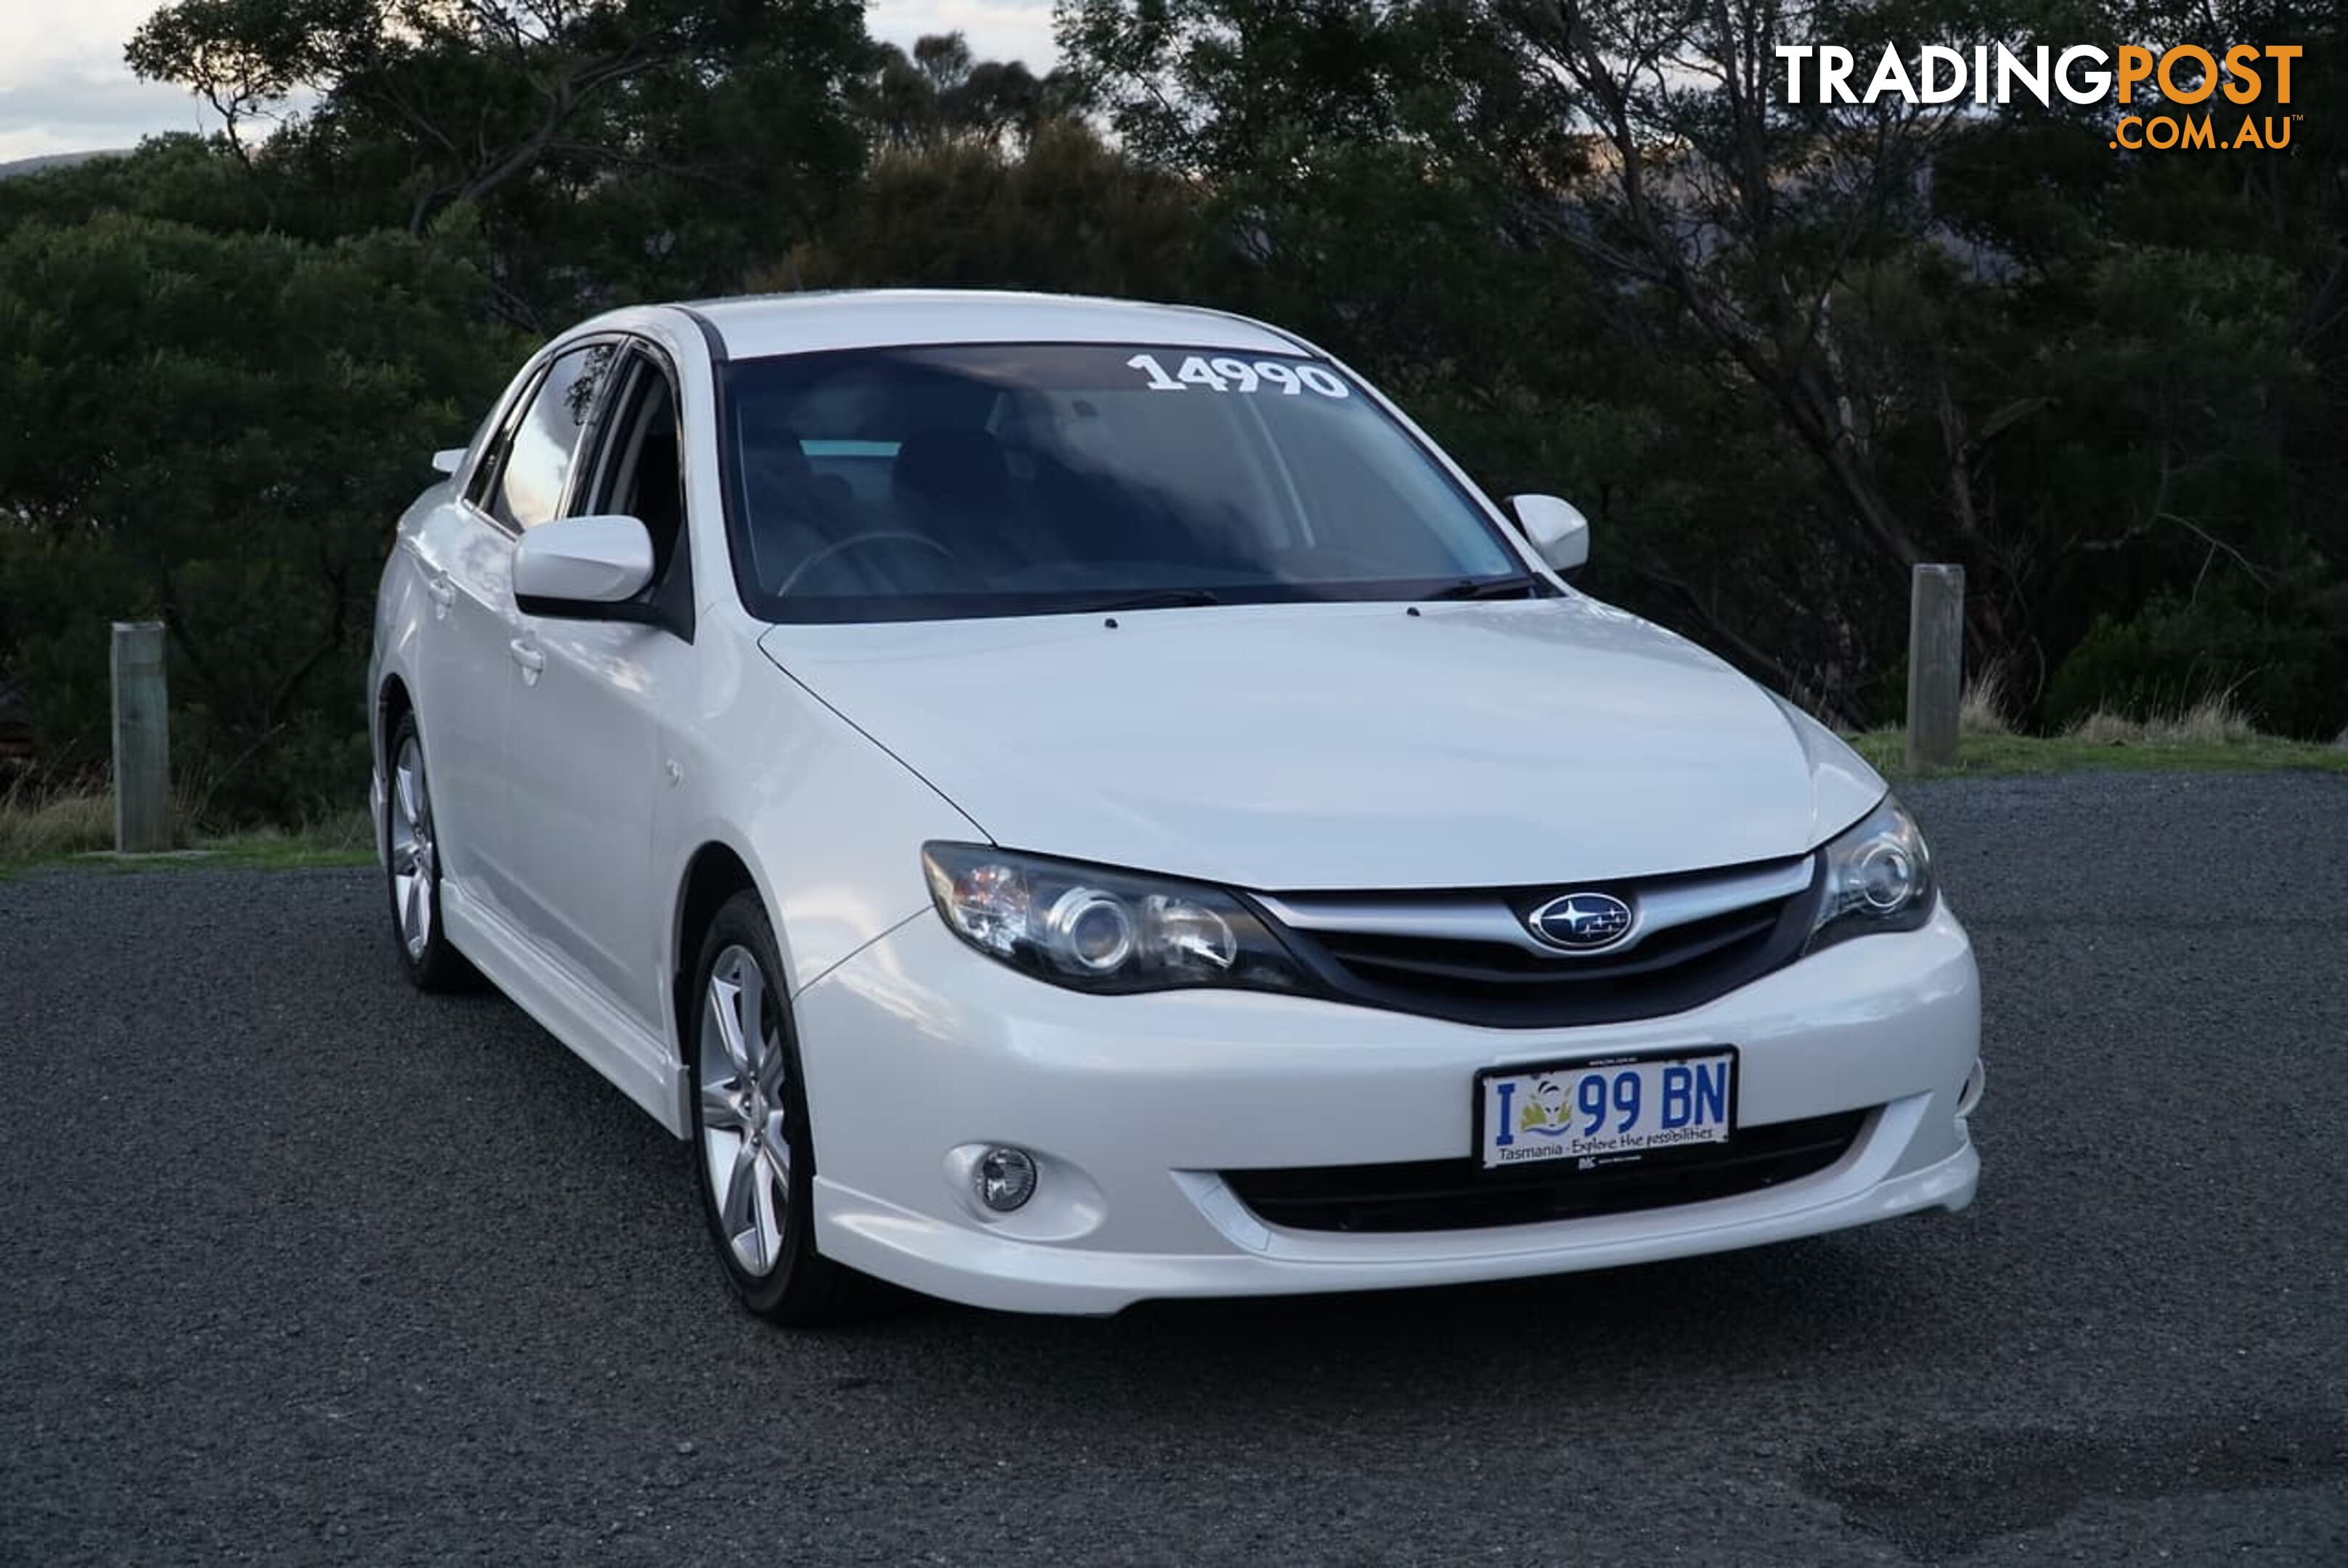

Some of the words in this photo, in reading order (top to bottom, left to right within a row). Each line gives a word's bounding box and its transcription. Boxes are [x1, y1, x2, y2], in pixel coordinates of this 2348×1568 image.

[1127, 354, 1349, 398] 14990
[1496, 1083, 1515, 1146] I
[1578, 1071, 1641, 1137] 99
[1662, 1062, 1726, 1129] BN
[1499, 1144, 1562, 1160] Tasmania
[1572, 1135, 1617, 1153] Explore
[1621, 1133, 1643, 1147] the
[1646, 1127, 1713, 1147] possibilities
